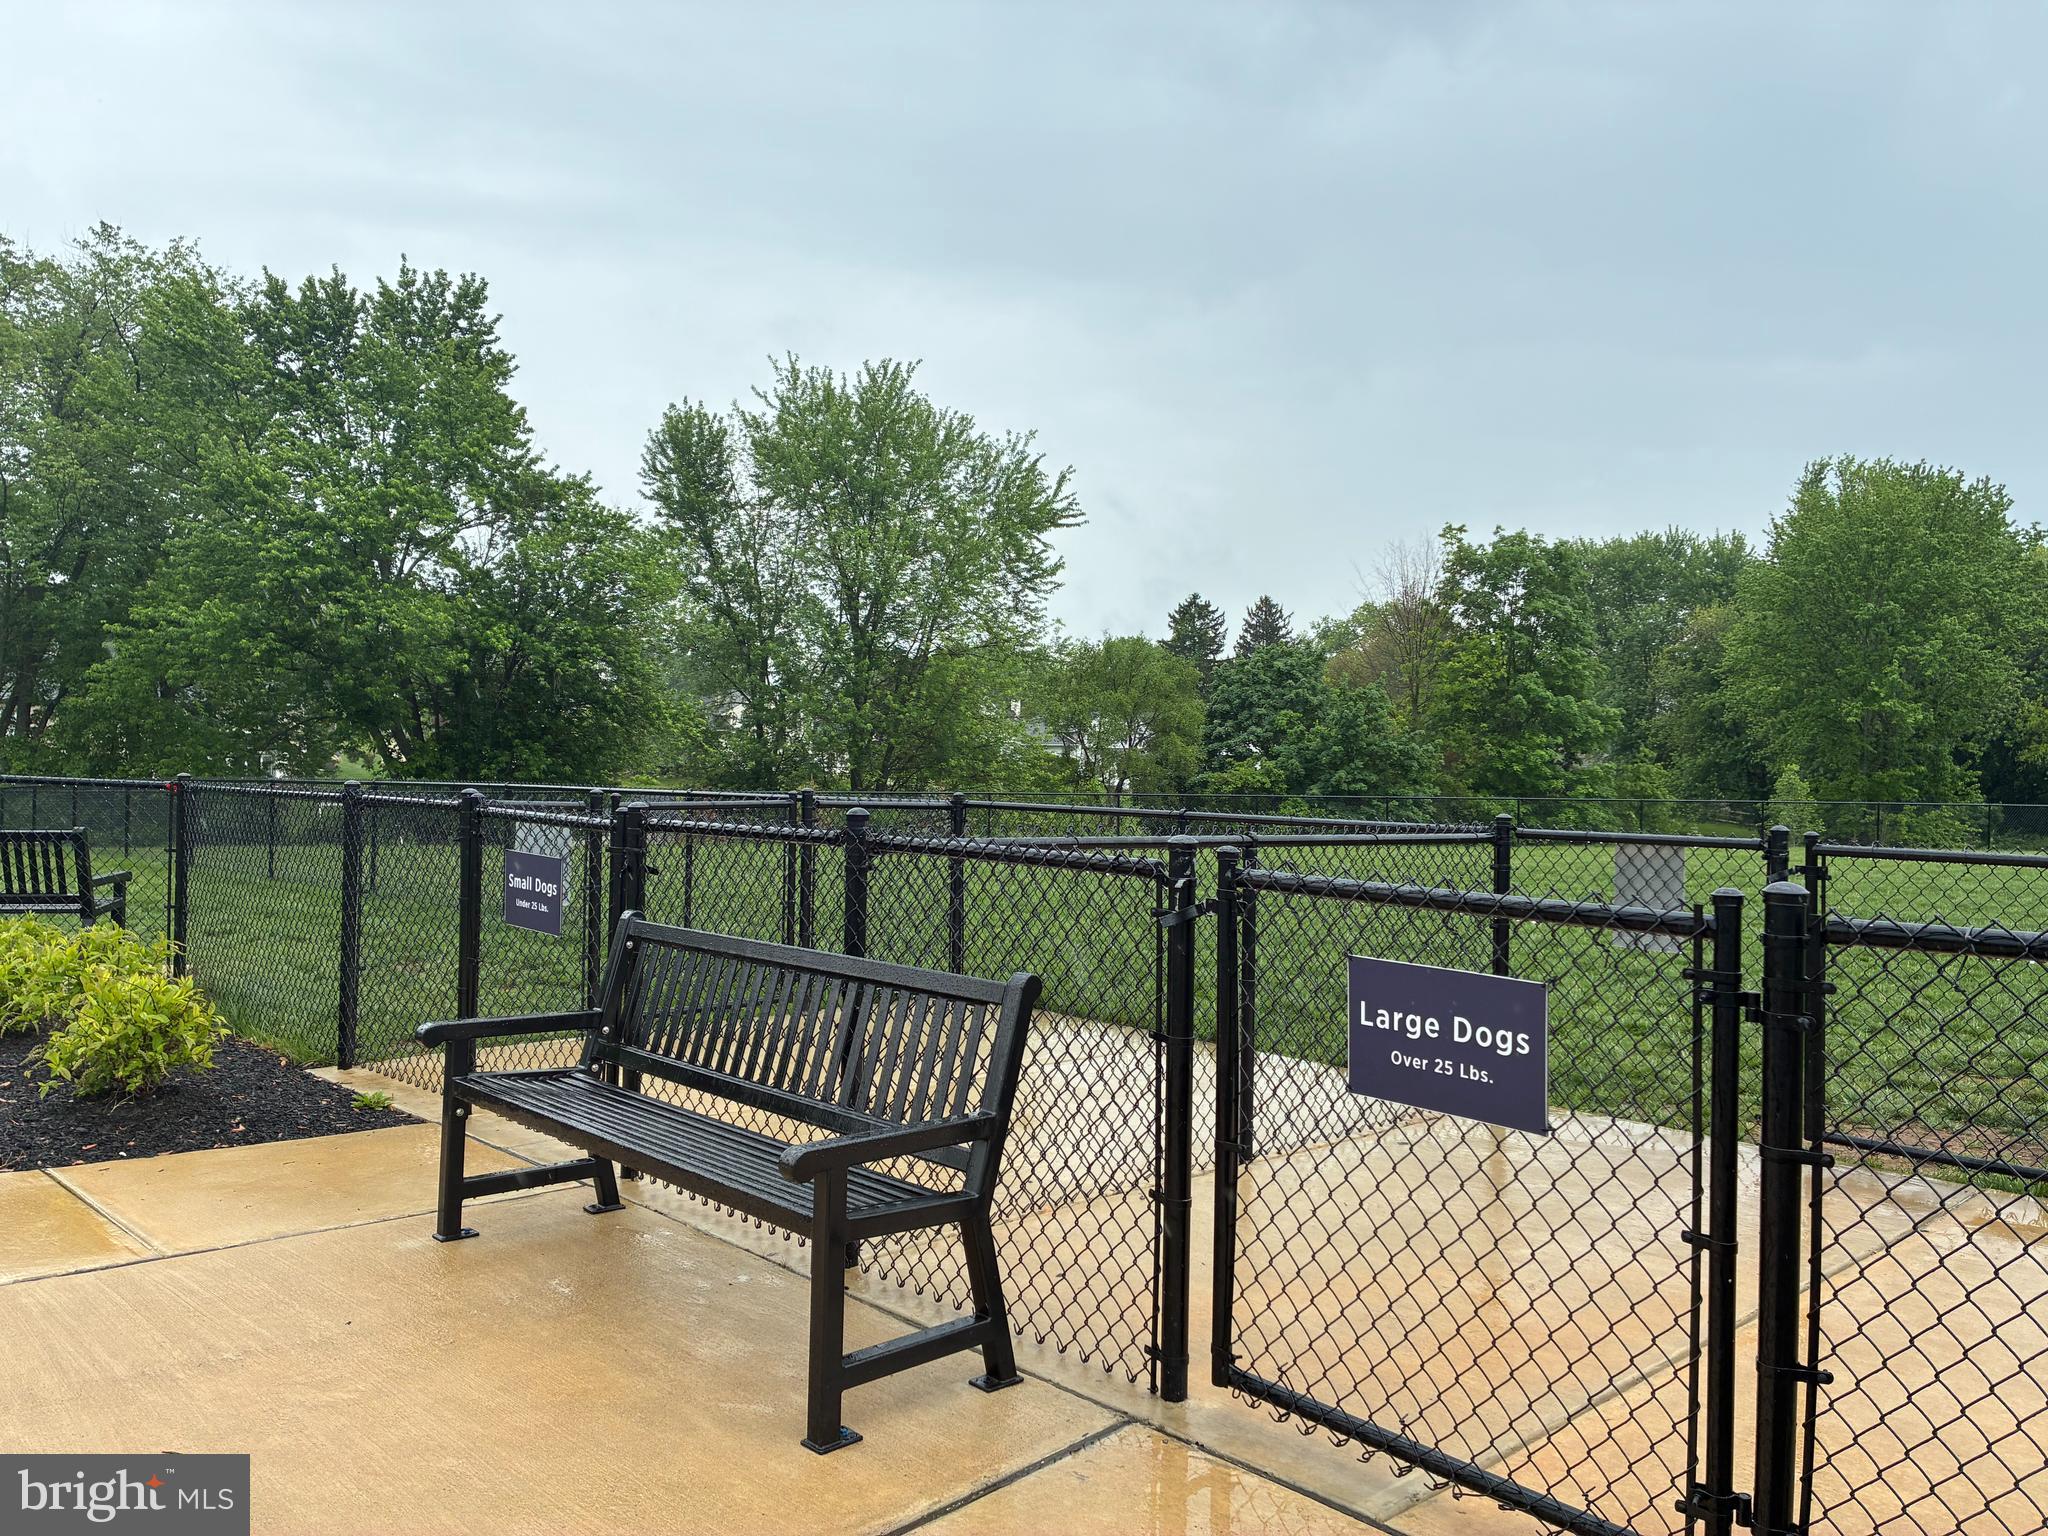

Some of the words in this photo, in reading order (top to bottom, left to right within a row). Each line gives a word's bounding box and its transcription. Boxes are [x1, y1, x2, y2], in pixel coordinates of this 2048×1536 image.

[508, 873, 532, 891] Small
[535, 878, 558, 897] Dogs
[515, 898, 531, 909] Under
[531, 901, 538, 910] 25
[538, 903, 549, 913] Lbs.
[1360, 1000, 1440, 1040] Large
[1453, 1015, 1530, 1056] Dogs
[1390, 1050, 1429, 1071] Over
[1434, 1058, 1454, 1075] 25
[1460, 1063, 1494, 1084] Lbs.
